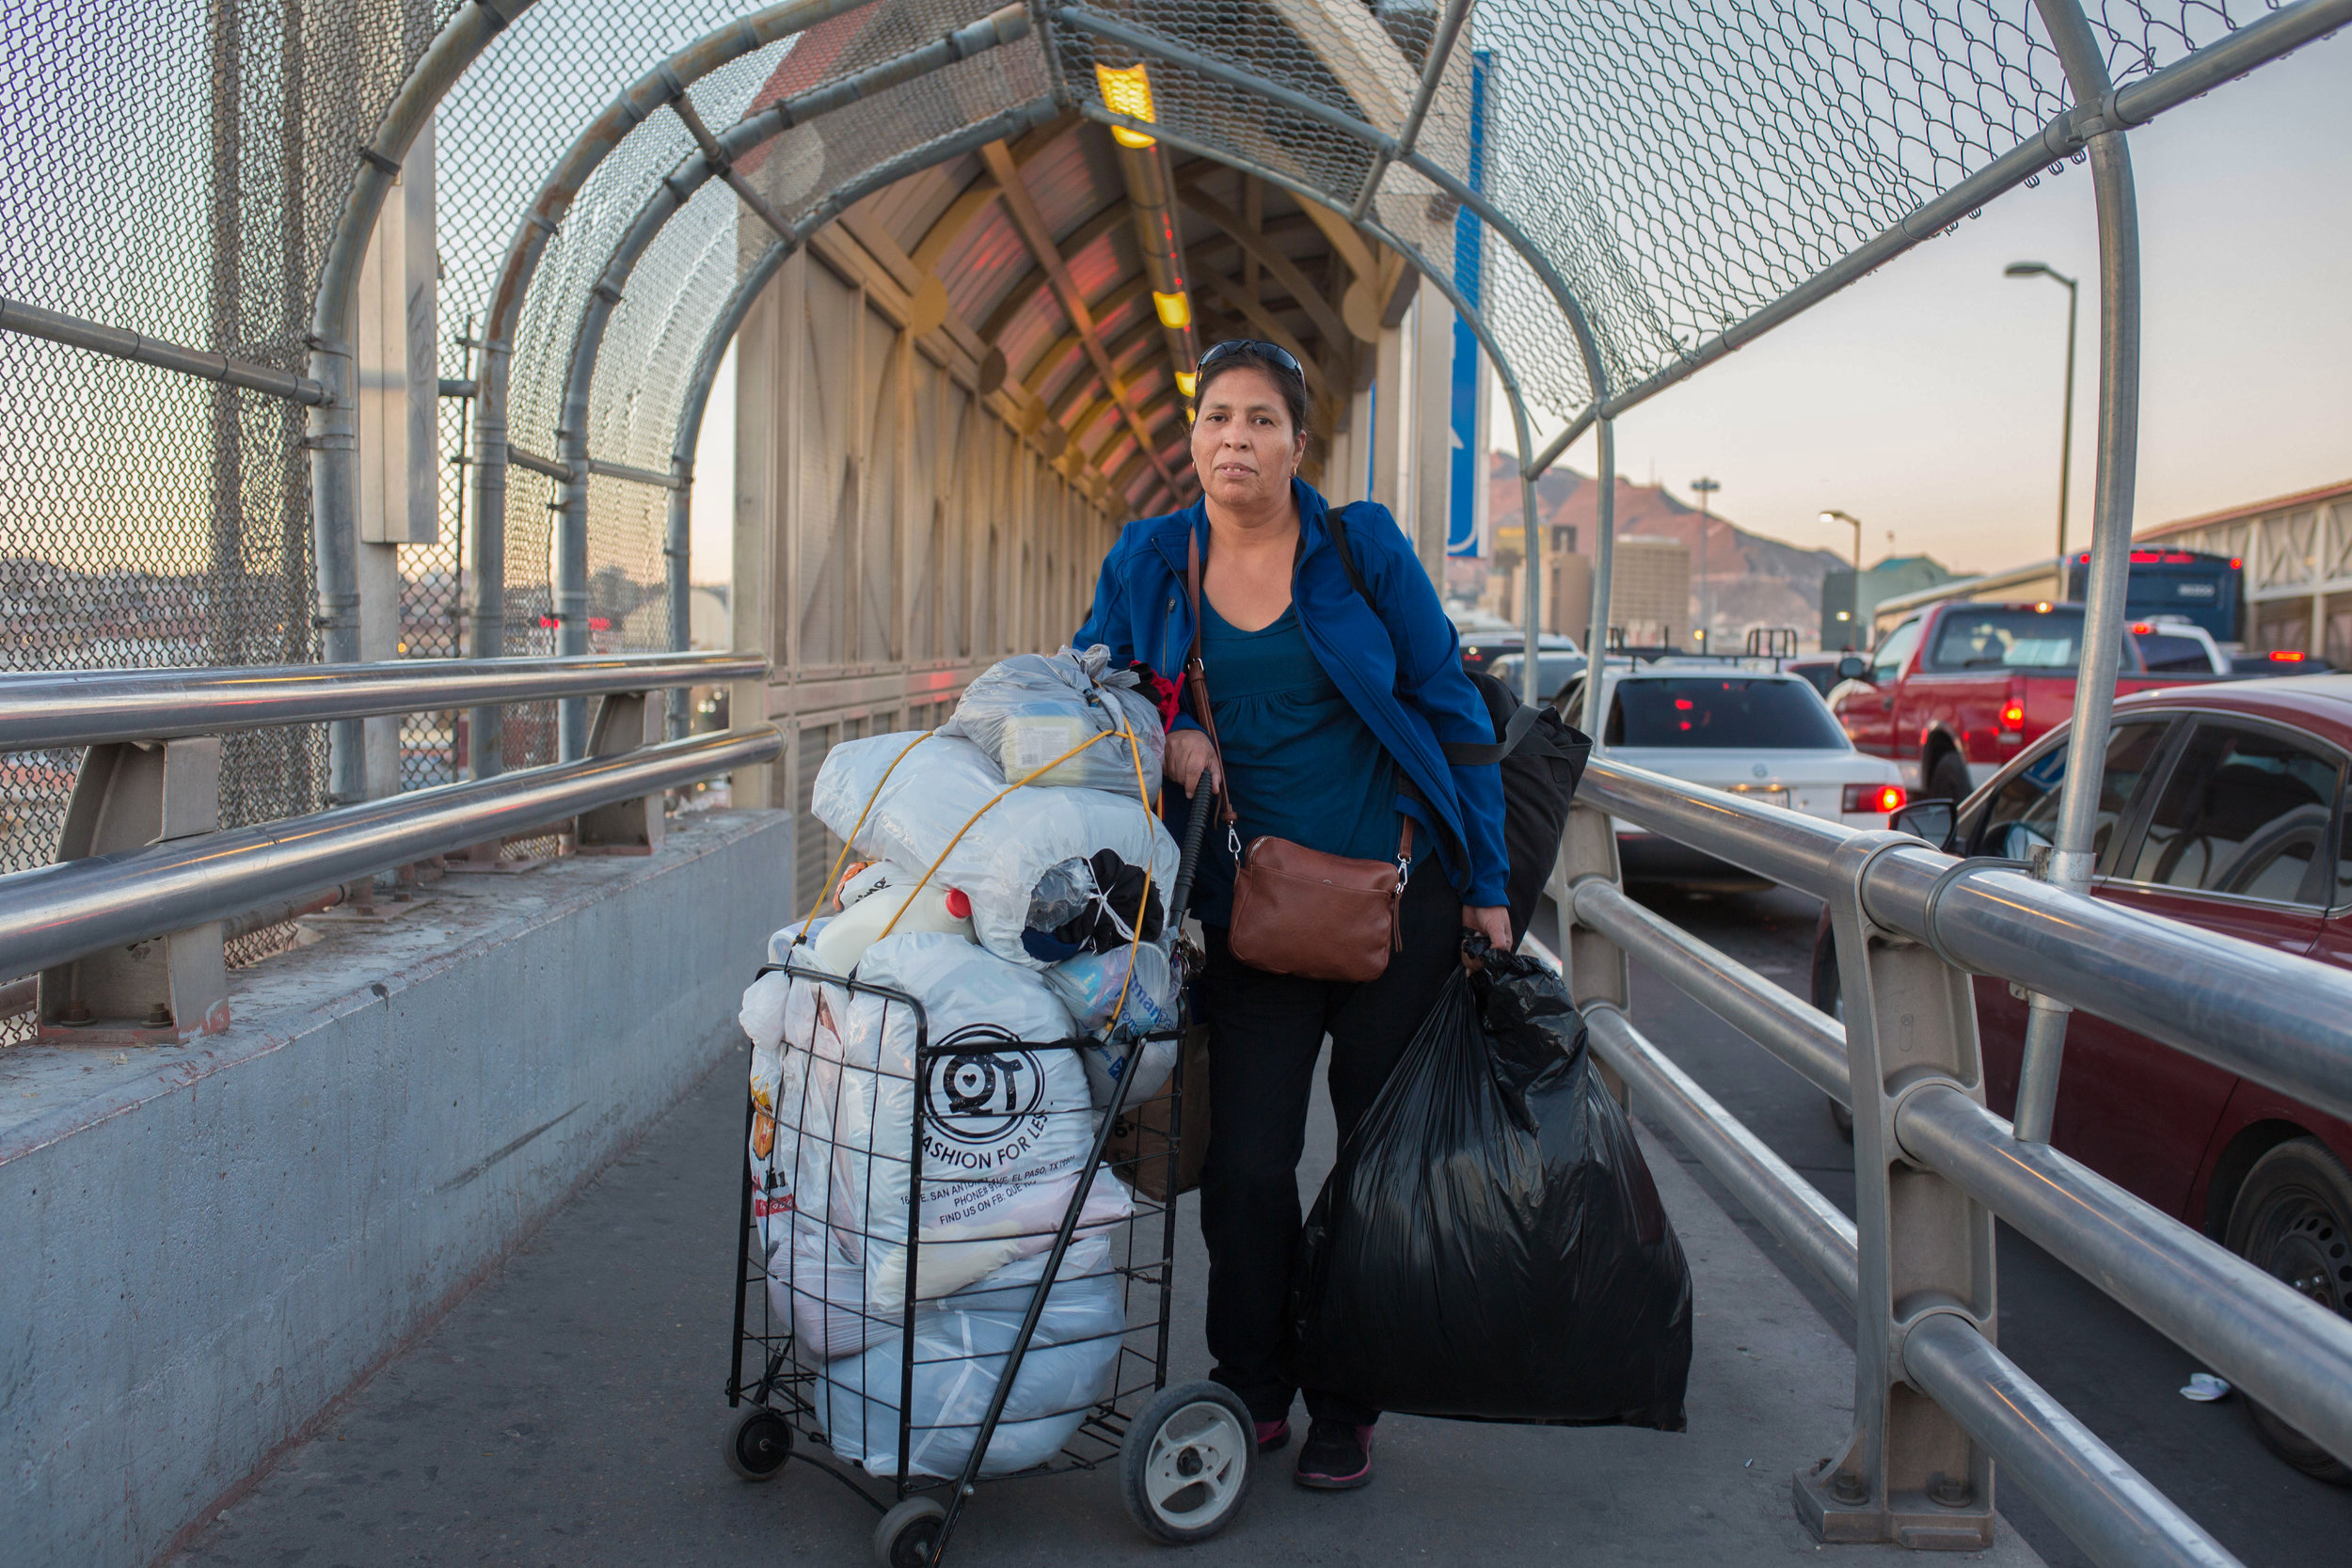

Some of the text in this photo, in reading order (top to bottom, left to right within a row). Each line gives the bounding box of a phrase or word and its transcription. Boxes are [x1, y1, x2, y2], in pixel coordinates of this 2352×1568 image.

[922, 1108, 1050, 1169] ASHION FOR LES
[930, 1188, 950, 1201] SAN
[1011, 1173, 1024, 1182] EL
[1024, 1165, 1047, 1180] PASO,
[1049, 1162, 1058, 1172] TX
[953, 1185, 989, 1208] PHONE#
[939, 1211, 961, 1225] FIND
[962, 1205, 977, 1218] US
[977, 1198, 992, 1212] ON
[992, 1192, 1006, 1205] FB:
[1006, 1183, 1024, 1197] QUE
